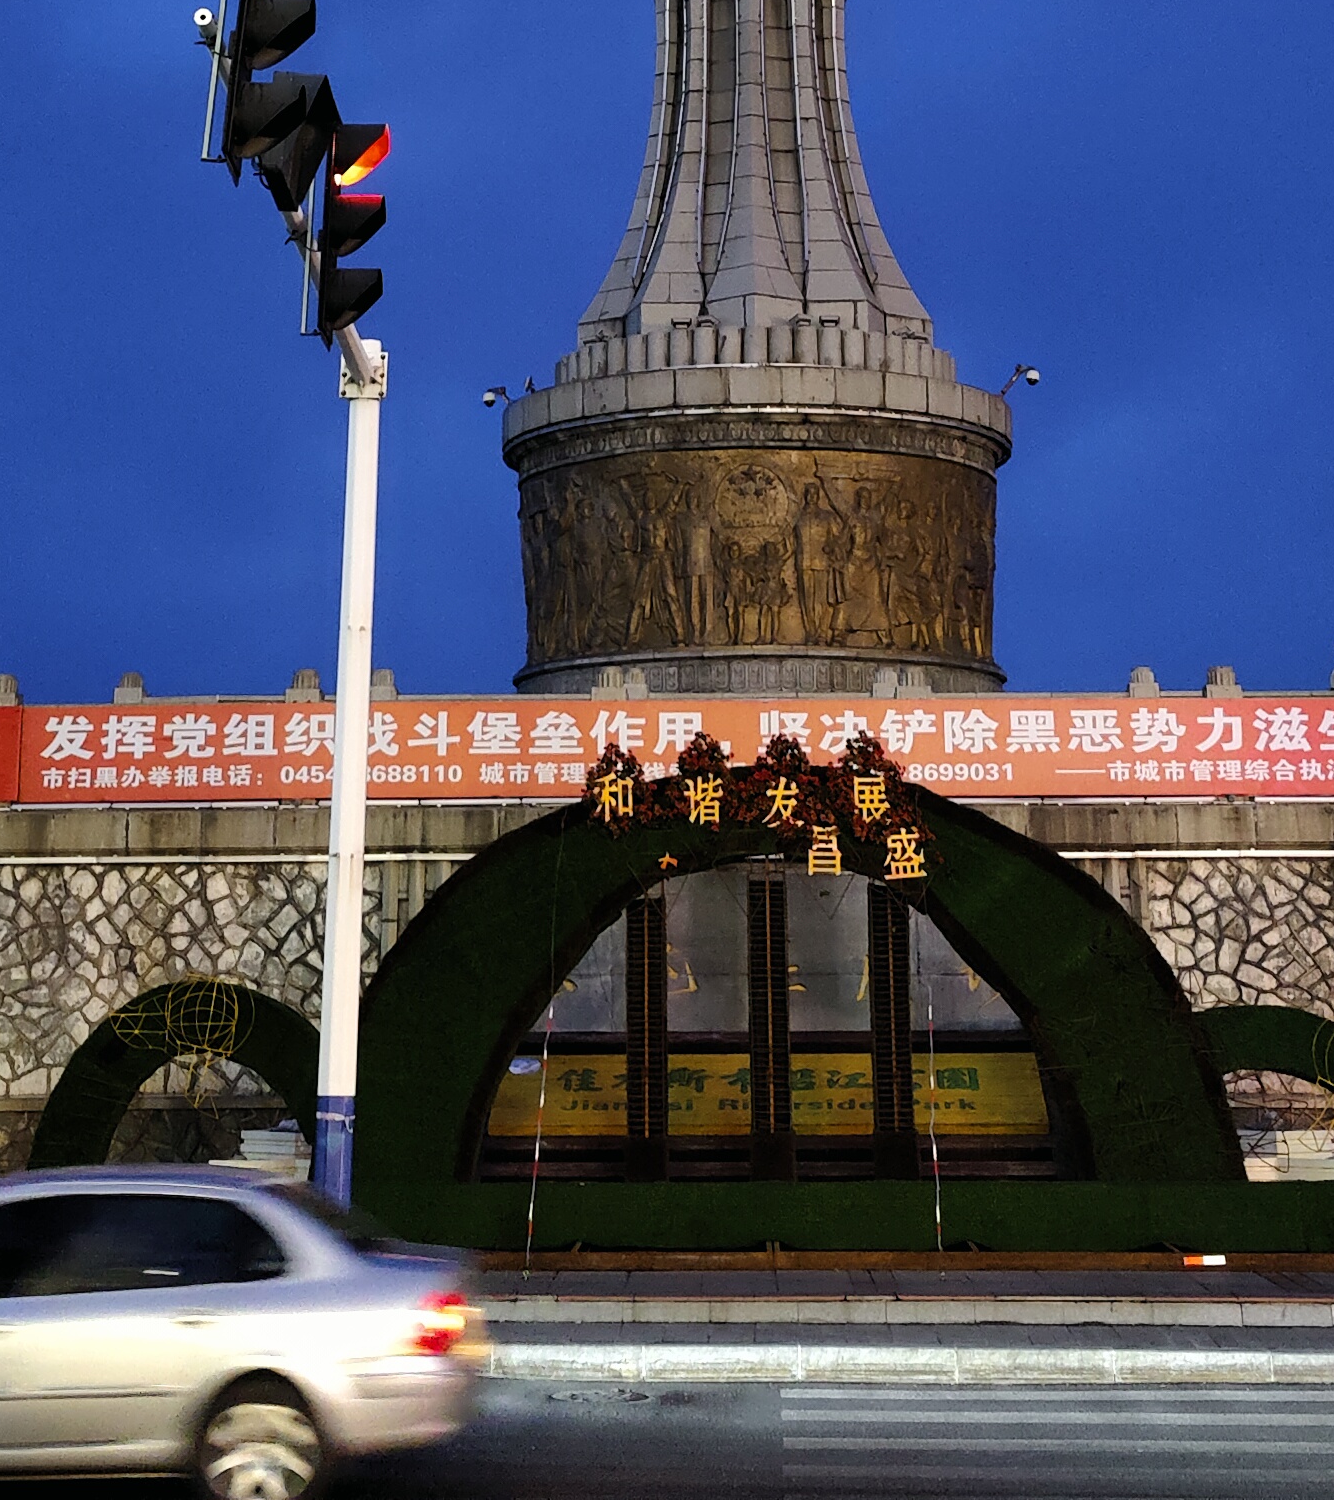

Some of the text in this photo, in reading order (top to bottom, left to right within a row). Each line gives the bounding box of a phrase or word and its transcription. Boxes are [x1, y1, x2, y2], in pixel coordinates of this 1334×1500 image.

[595, 773, 891, 827] 和谐发展
[807, 825, 928, 881] 昌盛
